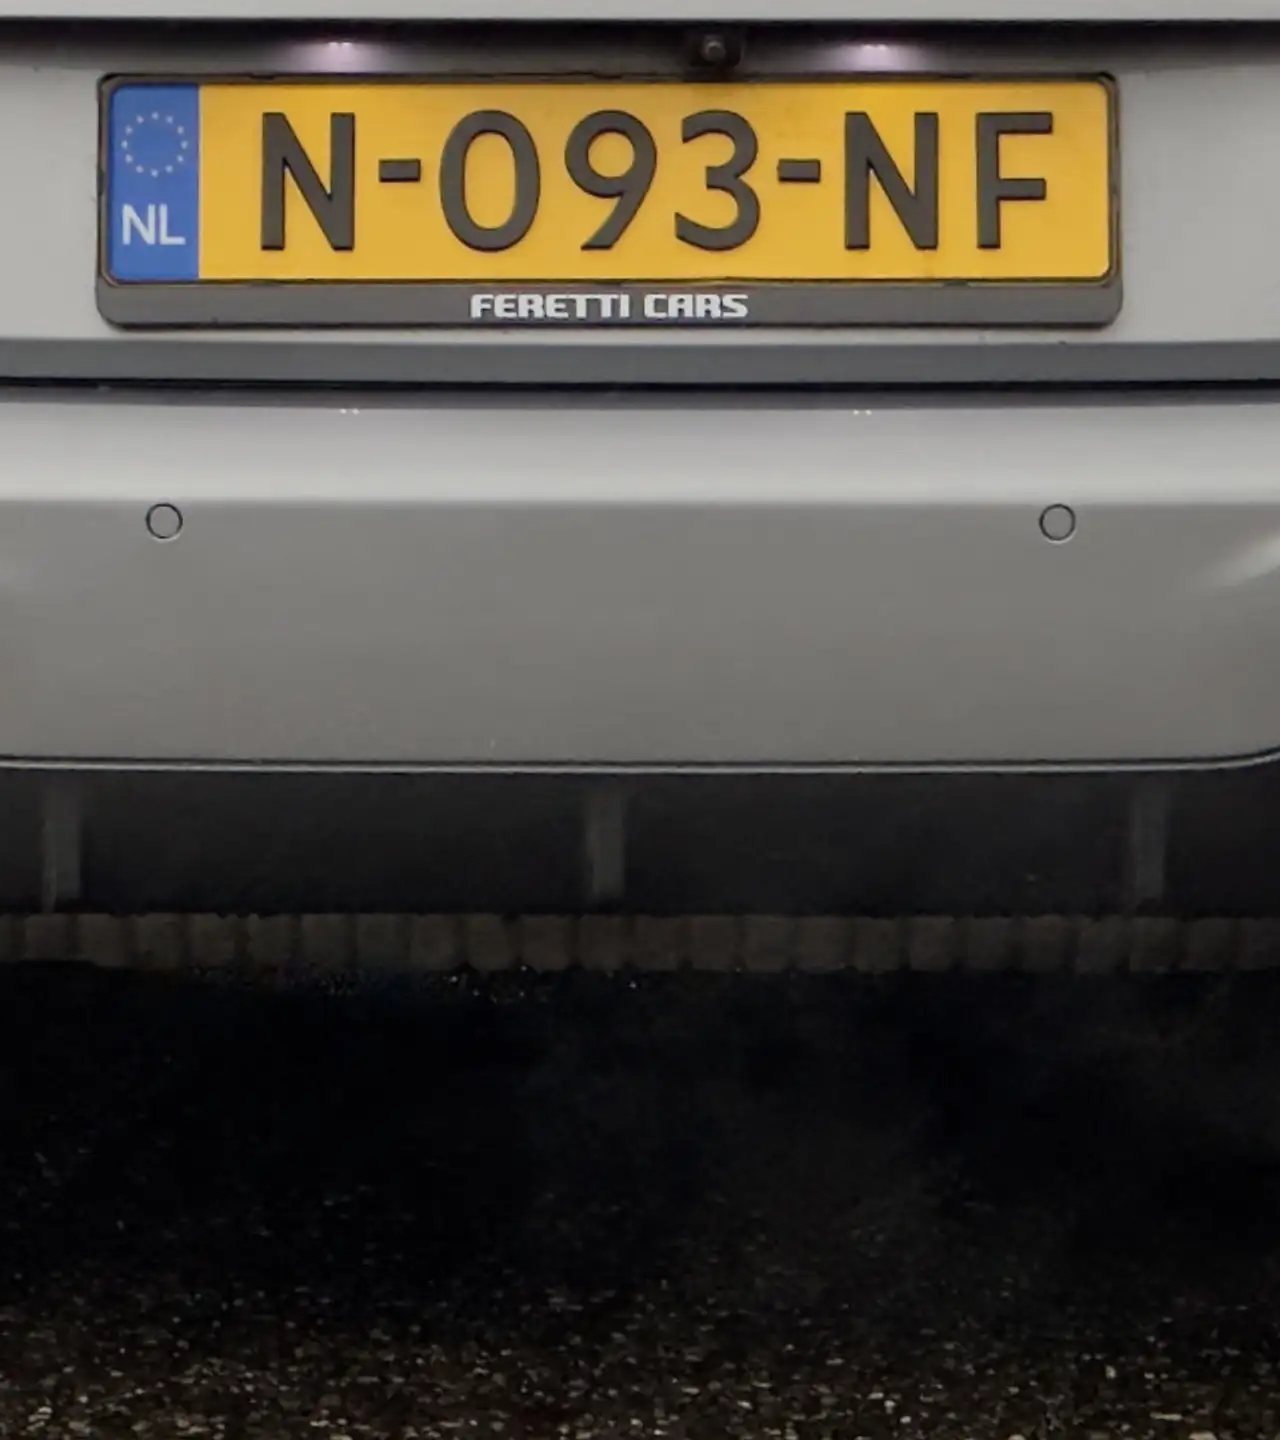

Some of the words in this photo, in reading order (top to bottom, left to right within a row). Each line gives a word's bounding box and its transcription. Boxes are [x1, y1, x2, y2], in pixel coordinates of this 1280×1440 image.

[260, 109, 1053, 252] N-093-NF
[122, 204, 186, 245] NL
[470, 294, 630, 318] FERETTI
[644, 294, 748, 318] CARS
